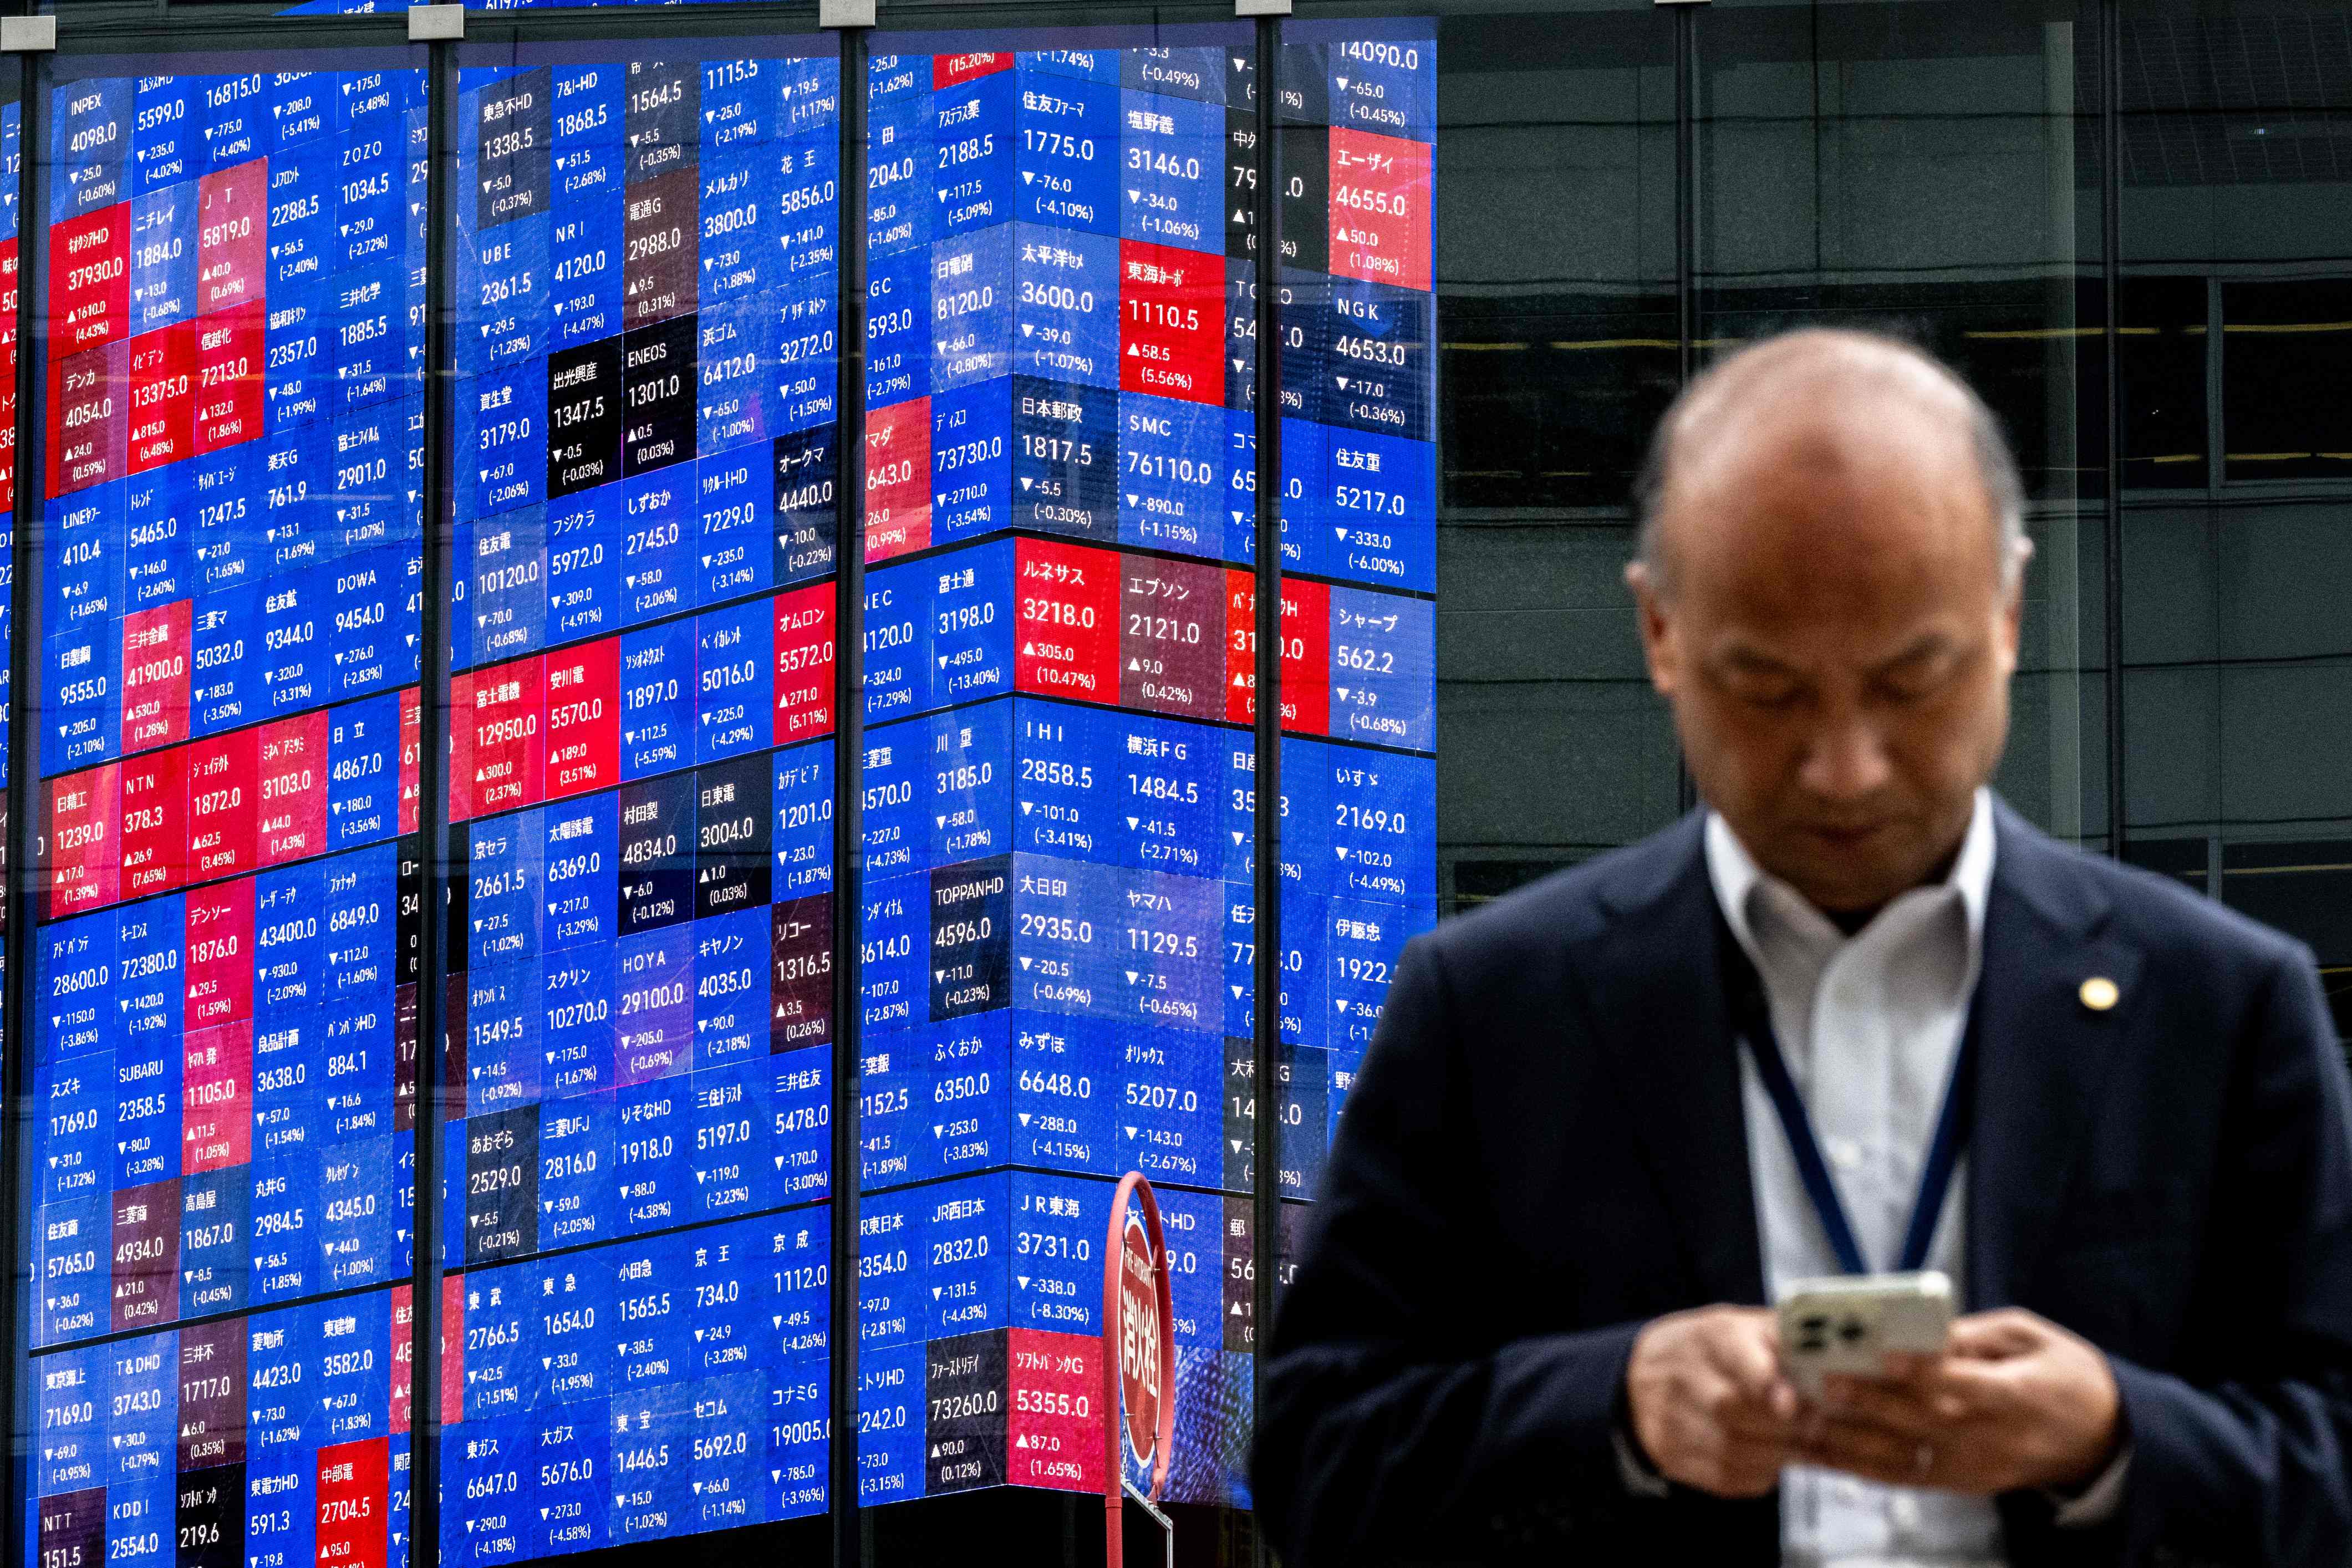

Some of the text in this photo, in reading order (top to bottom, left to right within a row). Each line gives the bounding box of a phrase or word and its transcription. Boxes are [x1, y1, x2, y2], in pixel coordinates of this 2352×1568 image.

[70, 92, 102, 116] INPEX
[483, 92, 533, 124] 東急不HD
[557, 103, 607, 137] 1868.5
[1127, 109, 1175, 136] 塩野義
[70, 121, 117, 152] 4098.0
[484, 126, 533, 160] 1338.5
[939, 133, 993, 169] 2188.5
[1024, 129, 1094, 161] 1775.0
[1128, 147, 1200, 180] 3146.0
[1336, 148, 1394, 174] エーザイ
[78, 180, 116, 206] (-0.60%)
[564, 166, 607, 193] (-2.68%)
[705, 170, 749, 198] メルカリ
[271, 194, 319, 227] 2288.5
[629, 197, 661, 221] 電通G
[948, 200, 992, 226] (-5.09%)
[1036, 197, 1094, 223] (-4.10%)
[1335, 185, 1406, 217] 4655.0
[704, 203, 757, 238] 3800.0
[1141, 214, 1200, 241] (-1.06%)
[628, 227, 681, 262] 2988.0
[68, 256, 123, 291] 37930.0
[936, 252, 974, 281] 日電硝
[1349, 251, 1400, 277] (1.08%)
[340, 281, 381, 309] 三井化学
[481, 271, 532, 306] 2361.5
[936, 285, 993, 321] 8120.0
[1020, 280, 1094, 313] 3600.0
[638, 291, 676, 318] (0.31%)
[1128, 299, 1199, 331] 1110.5
[75, 320, 109, 343] (4.43%)
[628, 342, 667, 368] ENEOS
[1335, 335, 1405, 366] 4653.0
[553, 362, 597, 390] 出光興産
[628, 374, 680, 407] 1301.0
[1141, 366, 1192, 390] (5.56%)
[133, 374, 188, 408] 13375.0
[480, 385, 512, 411] 資生堂
[65, 397, 112, 428] 4054.0
[554, 396, 604, 428] 1347.5
[1022, 396, 1083, 424] 日本郵政
[480, 417, 530, 450] 3179.0
[637, 439, 674, 465] (0.03%)
[780, 447, 824, 474] オークマ
[937, 436, 1002, 472] 73730.0
[1022, 434, 1092, 466] 1817.5
[1336, 448, 1381, 472] 住友重
[1127, 450, 1212, 485] 76110.0
[268, 480, 307, 510] 761.9
[779, 480, 832, 513] 4440.0
[1336, 485, 1405, 516] 5217.0
[946, 505, 991, 531] (-3.54%)
[1034, 502, 1092, 529] (-0.30%)
[130, 517, 177, 548] 5465.0
[63, 539, 101, 566] 410.4
[1348, 552, 1404, 577] (-6.00%)
[337, 569, 376, 594] DOWA
[939, 568, 975, 594] 富士通
[1023, 561, 1085, 586] ルネサス
[1128, 577, 1190, 600] エプソン
[335, 602, 385, 633] 9454.0
[780, 608, 825, 633] オムロン
[939, 602, 995, 634] 3198.0
[1023, 597, 1094, 629] 3218.0
[1338, 608, 1399, 633] シャープ
[1128, 613, 1200, 644] 2121.0
[780, 640, 833, 673] 5572.0
[1337, 644, 1394, 674] 562.2
[60, 676, 106, 706] 9555.0
[948, 666, 1000, 694] (-13.40%)
[1037, 666, 1096, 691] (10.47%)
[1141, 681, 1193, 705] (0.42%)
[477, 714, 537, 747] 12950.0
[1350, 712, 1407, 737] (-0.68%)
[262, 769, 312, 800] 3103.0
[1021, 758, 1093, 788] 2858.5
[485, 781, 522, 805] (2.37%)
[1128, 773, 1198, 804] 1484.5
[124, 806, 163, 833] 378.3
[700, 816, 754, 848] 3004.0
[1336, 803, 1406, 834] 2169.0
[57, 821, 104, 850] 1239.0
[1035, 827, 1092, 852] (-3.41%)
[548, 852, 600, 882] 6369.0
[1140, 842, 1198, 866] (-2.71%)
[133, 866, 166, 889] (7.65%)
[474, 868, 525, 899] 2661.5
[935, 876, 1004, 905] TOPPANHD
[1019, 874, 1068, 898] 大日印
[1126, 889, 1173, 912] ヤマハ
[935, 917, 991, 948] 4596.0
[1020, 913, 1092, 944] 2935.0
[1127, 928, 1198, 958] 1129.5
[121, 949, 177, 980] 72380.0
[777, 951, 831, 981] 1316.5
[53, 965, 109, 996] 28600.0
[621, 982, 684, 1016] 29100.0
[934, 1036, 982, 1062] ふくおか
[1019, 1031, 1065, 1053] みずほ
[119, 1059, 164, 1083] SUBARU
[257, 1063, 306, 1092] 3638.0
[328, 1050, 366, 1077] 884.1
[934, 1072, 990, 1103] 6350.0
[1019, 1070, 1091, 1099] 6648.0
[1126, 1082, 1198, 1112] 5207.0
[50, 1108, 98, 1137] 1769.0
[545, 1116, 590, 1139] 三菱UFJ
[776, 1104, 829, 1134] 5478.0
[1032, 1138, 1090, 1162] (-4.15%)
[1138, 1151, 1197, 1175] (-2.67%)
[471, 1165, 521, 1194] 2529.0
[544, 1150, 597, 1180] 2816.0
[932, 1197, 985, 1223] JR西日本
[115, 1236, 164, 1264] 4934.0
[933, 1235, 989, 1265] 2832.0
[1017, 1231, 1090, 1261] 3731.0
[773, 1264, 827, 1293] 1112.0
[695, 1280, 739, 1307] 734.0
[942, 1304, 987, 1325] (-4.43%)
[1123, 1285, 1157, 1398] 消火栓
[323, 1348, 373, 1377] 3582.0
[183, 1375, 231, 1403] 1717.0
[1016, 1388, 1089, 1418] 5355.0
[931, 1390, 997, 1422] 73260.0
[541, 1458, 593, 1486] 5676.0
[941, 1460, 981, 1483] (0.12%)
[1030, 1459, 1082, 1481] (1.65%)
[466, 1471, 517, 1499] 6647.0
[251, 1510, 290, 1536] 591.3
[321, 1496, 370, 1524] 2704.5
[180, 1522, 220, 1548] 219.6
